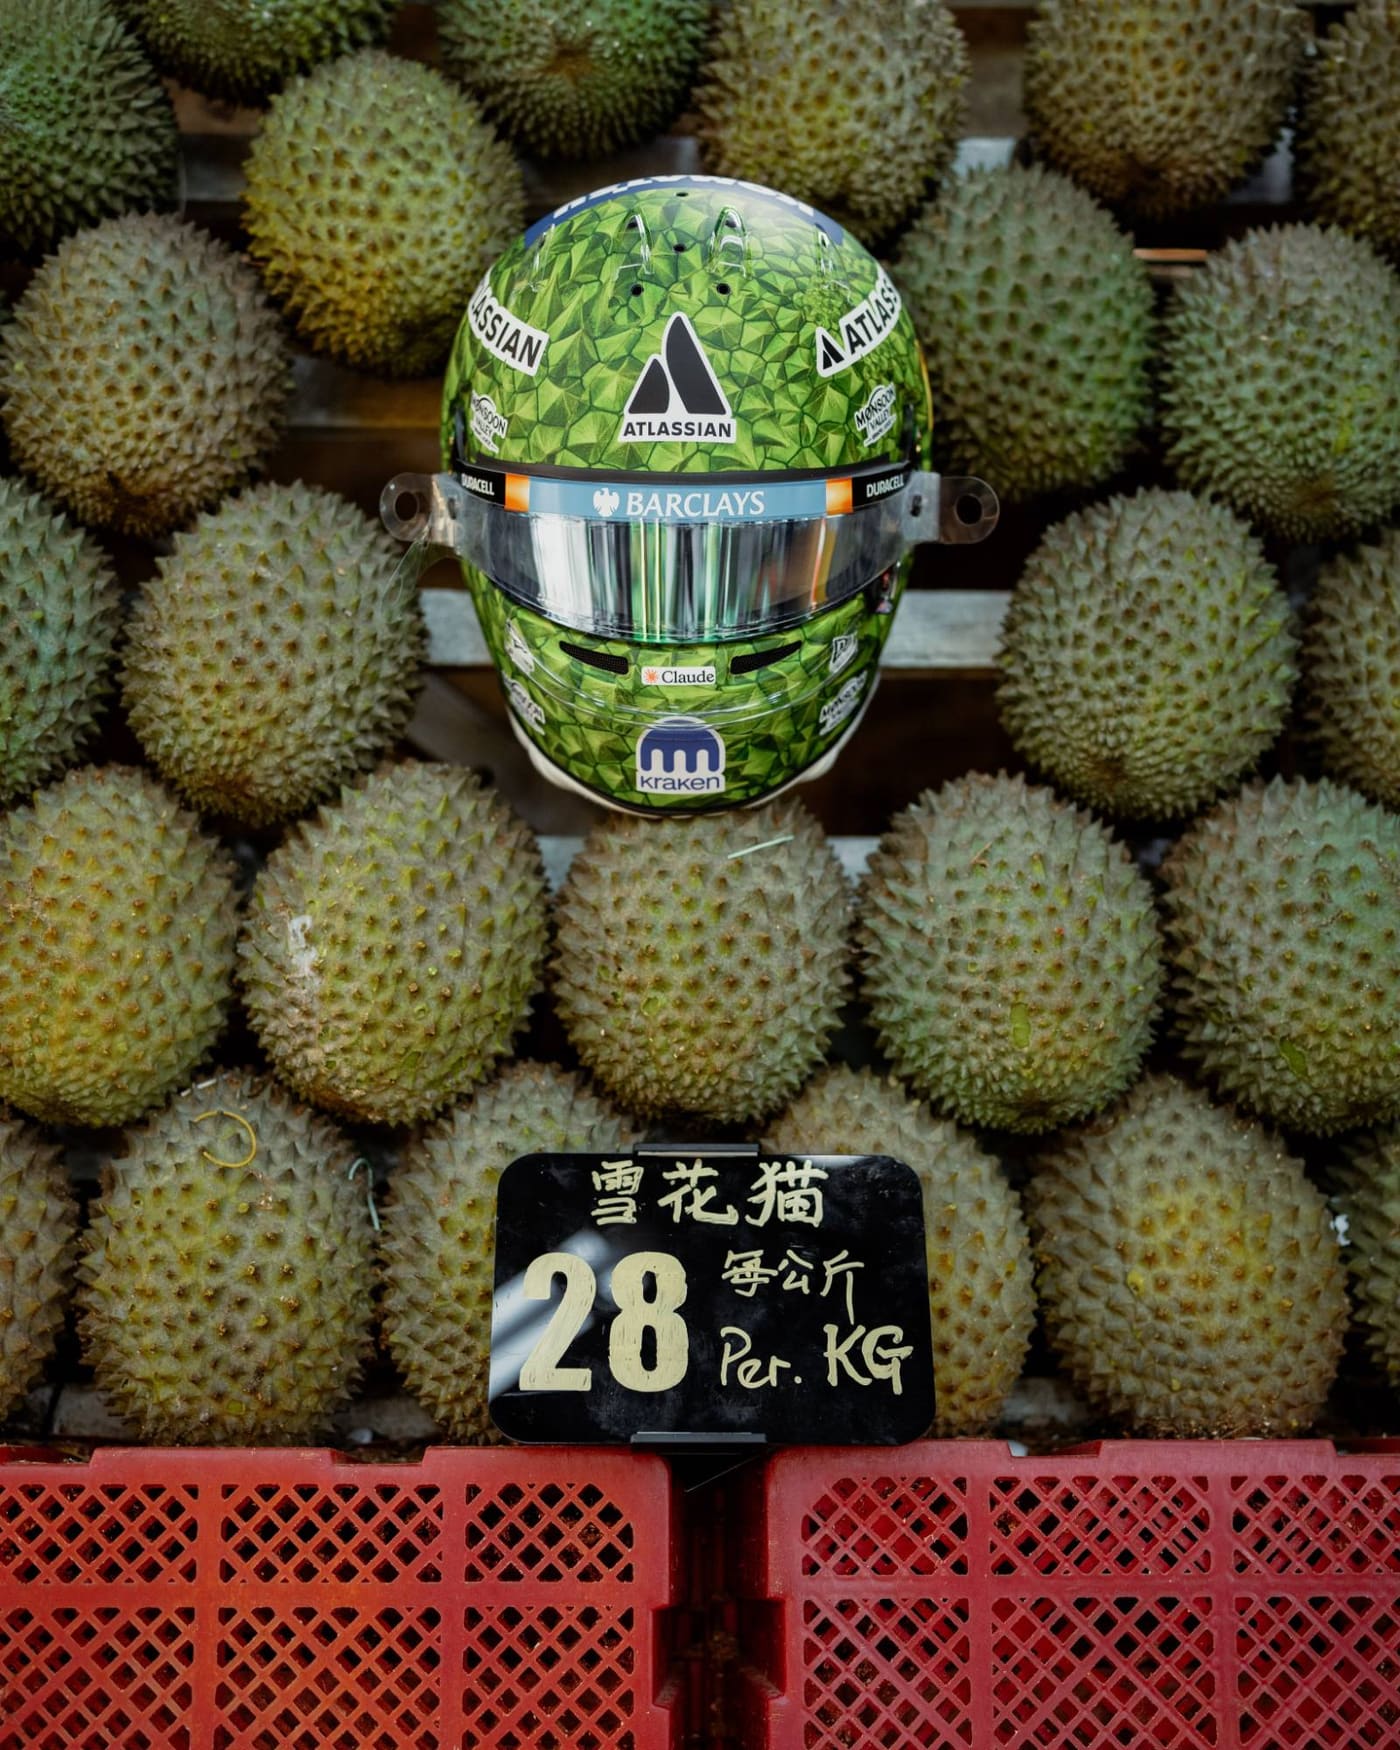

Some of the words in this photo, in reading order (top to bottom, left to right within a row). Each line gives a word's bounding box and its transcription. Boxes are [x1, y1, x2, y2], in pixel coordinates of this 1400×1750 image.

[623, 422, 731, 438] ATLASSIAN
[461, 473, 495, 496] DURACELL
[866, 473, 904, 498] DURACELL
[626, 490, 765, 517] BARCLAYS
[661, 669, 715, 684] Claude
[640, 775, 720, 791] kraken
[590, 1158, 829, 1228] 雪花猫
[721, 1248, 865, 1325] 每公斤
[518, 1251, 689, 1393] 28
[720, 1326, 802, 1389] Per.
[823, 1324, 914, 1396] KG
